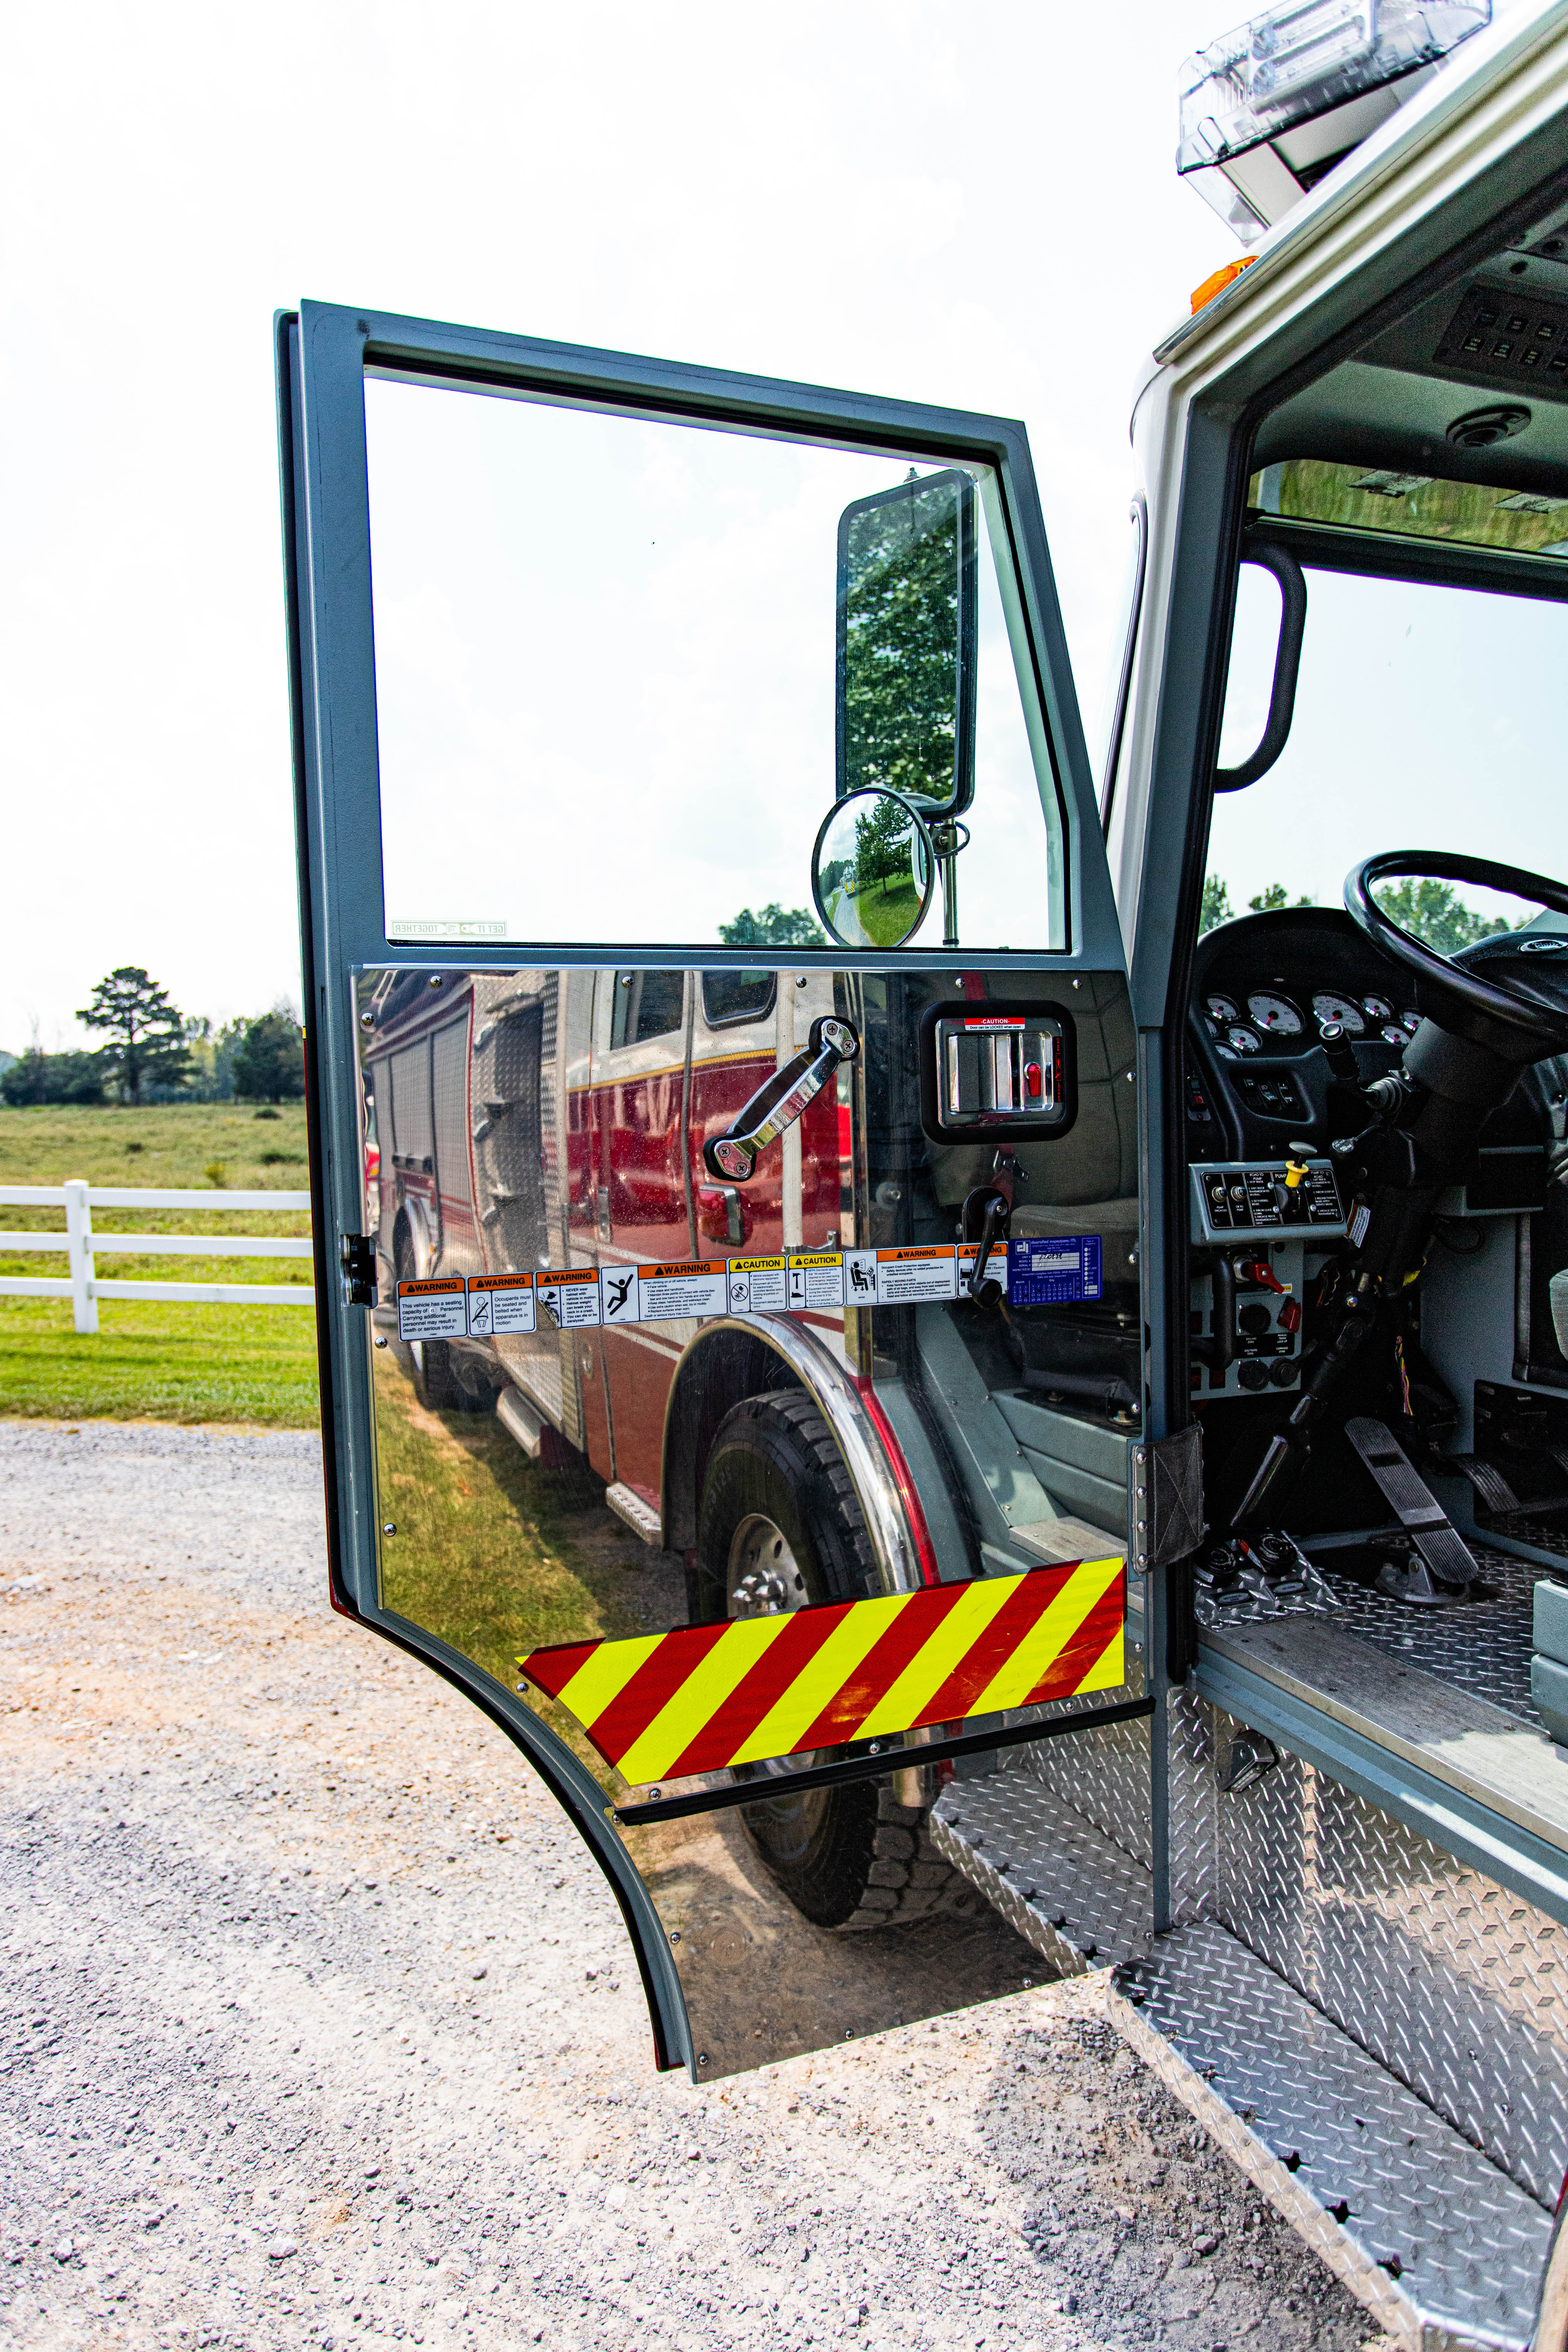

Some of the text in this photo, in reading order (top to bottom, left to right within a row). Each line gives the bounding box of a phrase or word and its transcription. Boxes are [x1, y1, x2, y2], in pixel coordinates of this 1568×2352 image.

[664, 1263, 710, 1274] WARNING
[743, 1260, 780, 1268] CAUTION
[484, 1277, 525, 1287] WARNING
[552, 1272, 591, 1282] WARNING
[415, 1282, 457, 1292] WARNING
